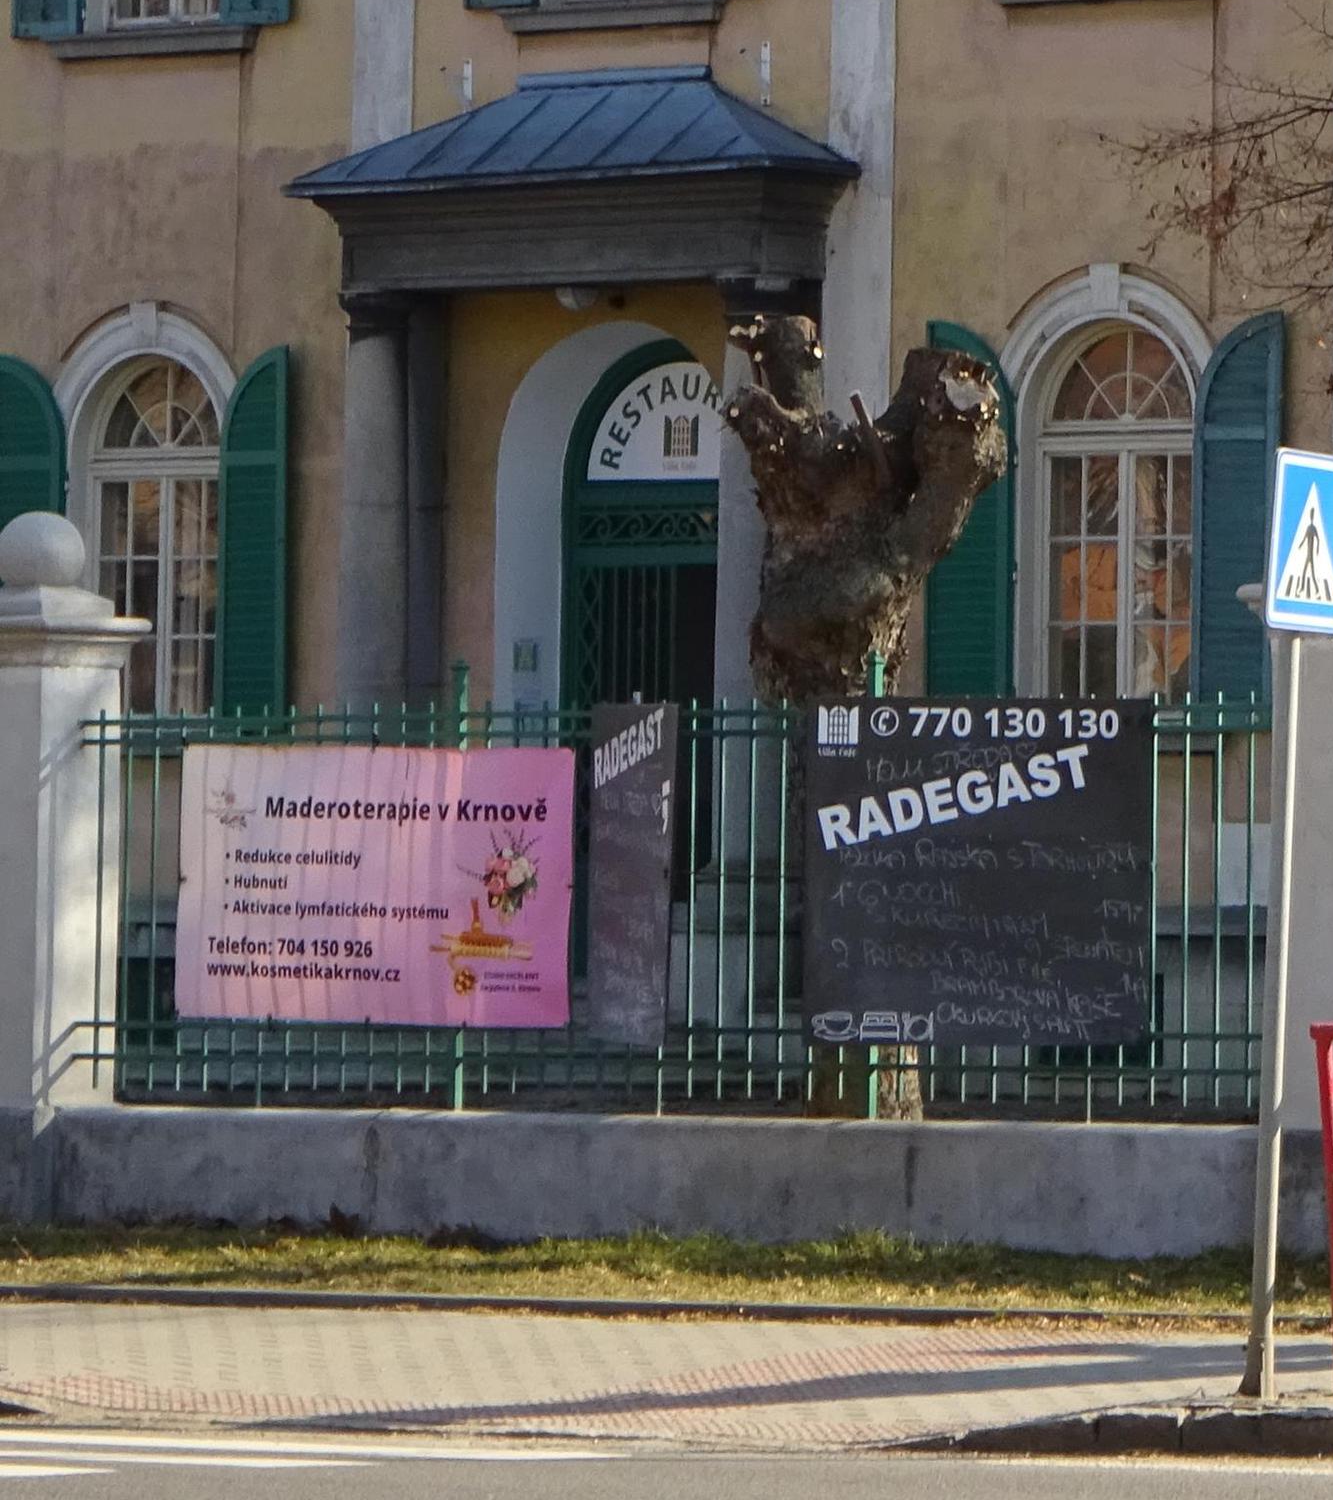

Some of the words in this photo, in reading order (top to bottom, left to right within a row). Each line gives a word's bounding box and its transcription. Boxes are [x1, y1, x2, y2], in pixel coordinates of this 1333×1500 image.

[600, 373, 724, 470] RESTAUR
[908, 707, 972, 738] 770
[984, 707, 1046, 739] 130
[1058, 708, 1120, 739] 130
[594, 707, 664, 790] RADEGAST
[817, 744, 1089, 850] RADEGAST
[265, 796, 430, 827] Maderoterapie
[437, 802, 449, 821] v
[456, 797, 548, 823] Krnově
[235, 849, 292, 866] Redukce
[295, 849, 361, 869] celulitidy
[234, 873, 288, 890] Hubnutí
[233, 901, 292, 917] Aktivace
[295, 901, 387, 920] lymfatického
[391, 903, 449, 923] systému
[208, 937, 272, 957] Telefon:
[277, 938, 306, 956] 704
[312, 938, 339, 957] 150
[344, 939, 373, 958] 926
[206, 961, 401, 983] www.kosmetikakrnov.cz
